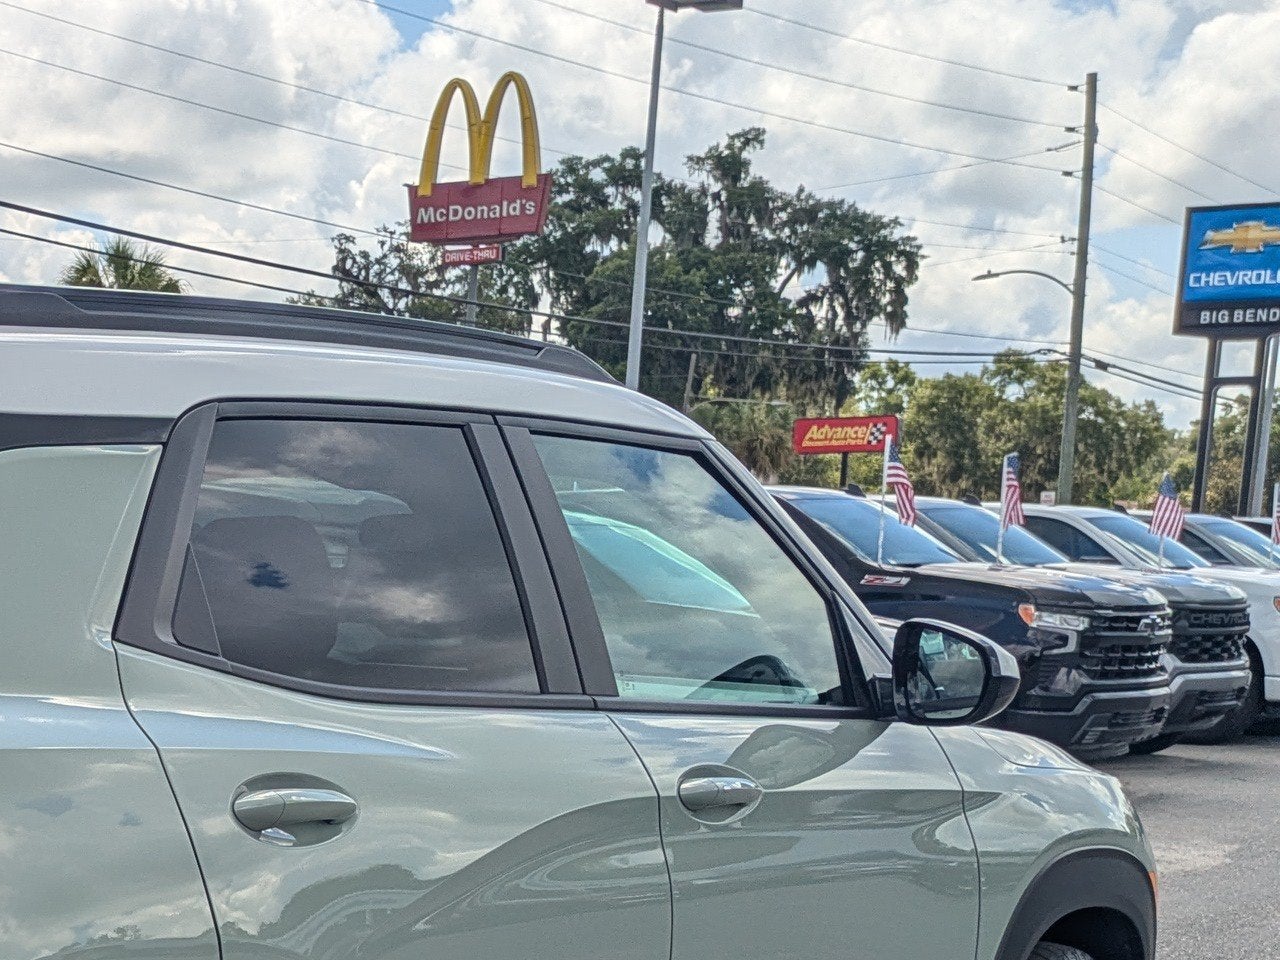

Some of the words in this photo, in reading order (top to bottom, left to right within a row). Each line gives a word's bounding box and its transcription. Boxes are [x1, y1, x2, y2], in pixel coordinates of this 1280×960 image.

[417, 199, 536, 224] McDonald's
[445, 248, 497, 263] DRIVE-THRU
[1189, 269, 1280, 287] CHEVROL
[1200, 309, 1229, 324] BIG
[1233, 308, 1280, 323] BEND
[804, 424, 866, 440] Advance
